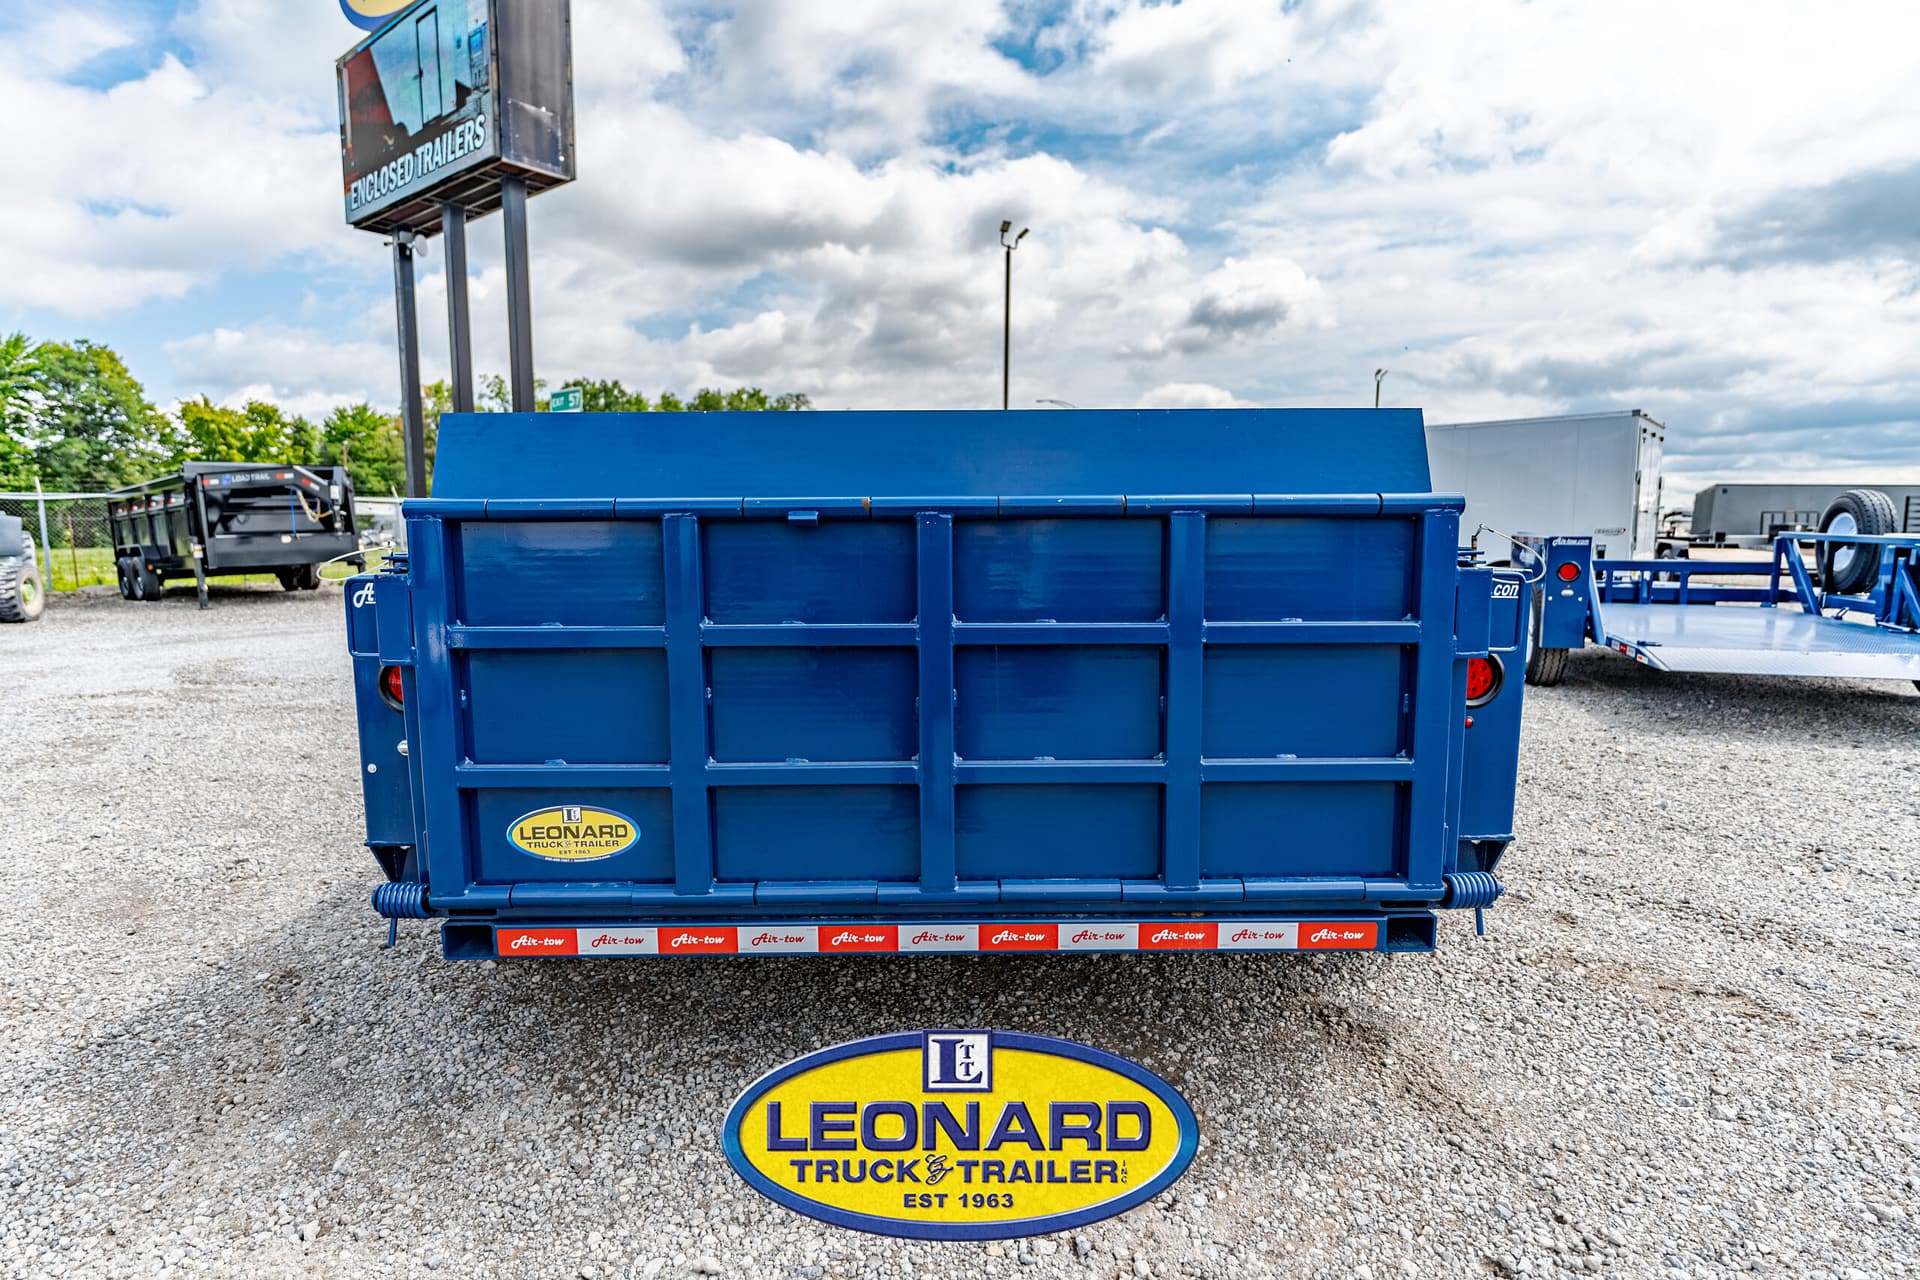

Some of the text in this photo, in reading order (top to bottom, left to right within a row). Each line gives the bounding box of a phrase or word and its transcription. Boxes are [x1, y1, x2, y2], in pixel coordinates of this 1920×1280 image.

[350, 114, 486, 210] ENCLOSED TRAILERS
[231, 472, 271, 482] LOAD TRAIL
[519, 824, 628, 840] LEONARD
[527, 841, 563, 849] TRUCK
[574, 840, 620, 848] TRAILER
[511, 928, 1364, 949] Air-tow Air-tow Air-tow Air-tow Air-tow Air-tow Air-tow Air-tow Air-tow Air-tow Air-tow
